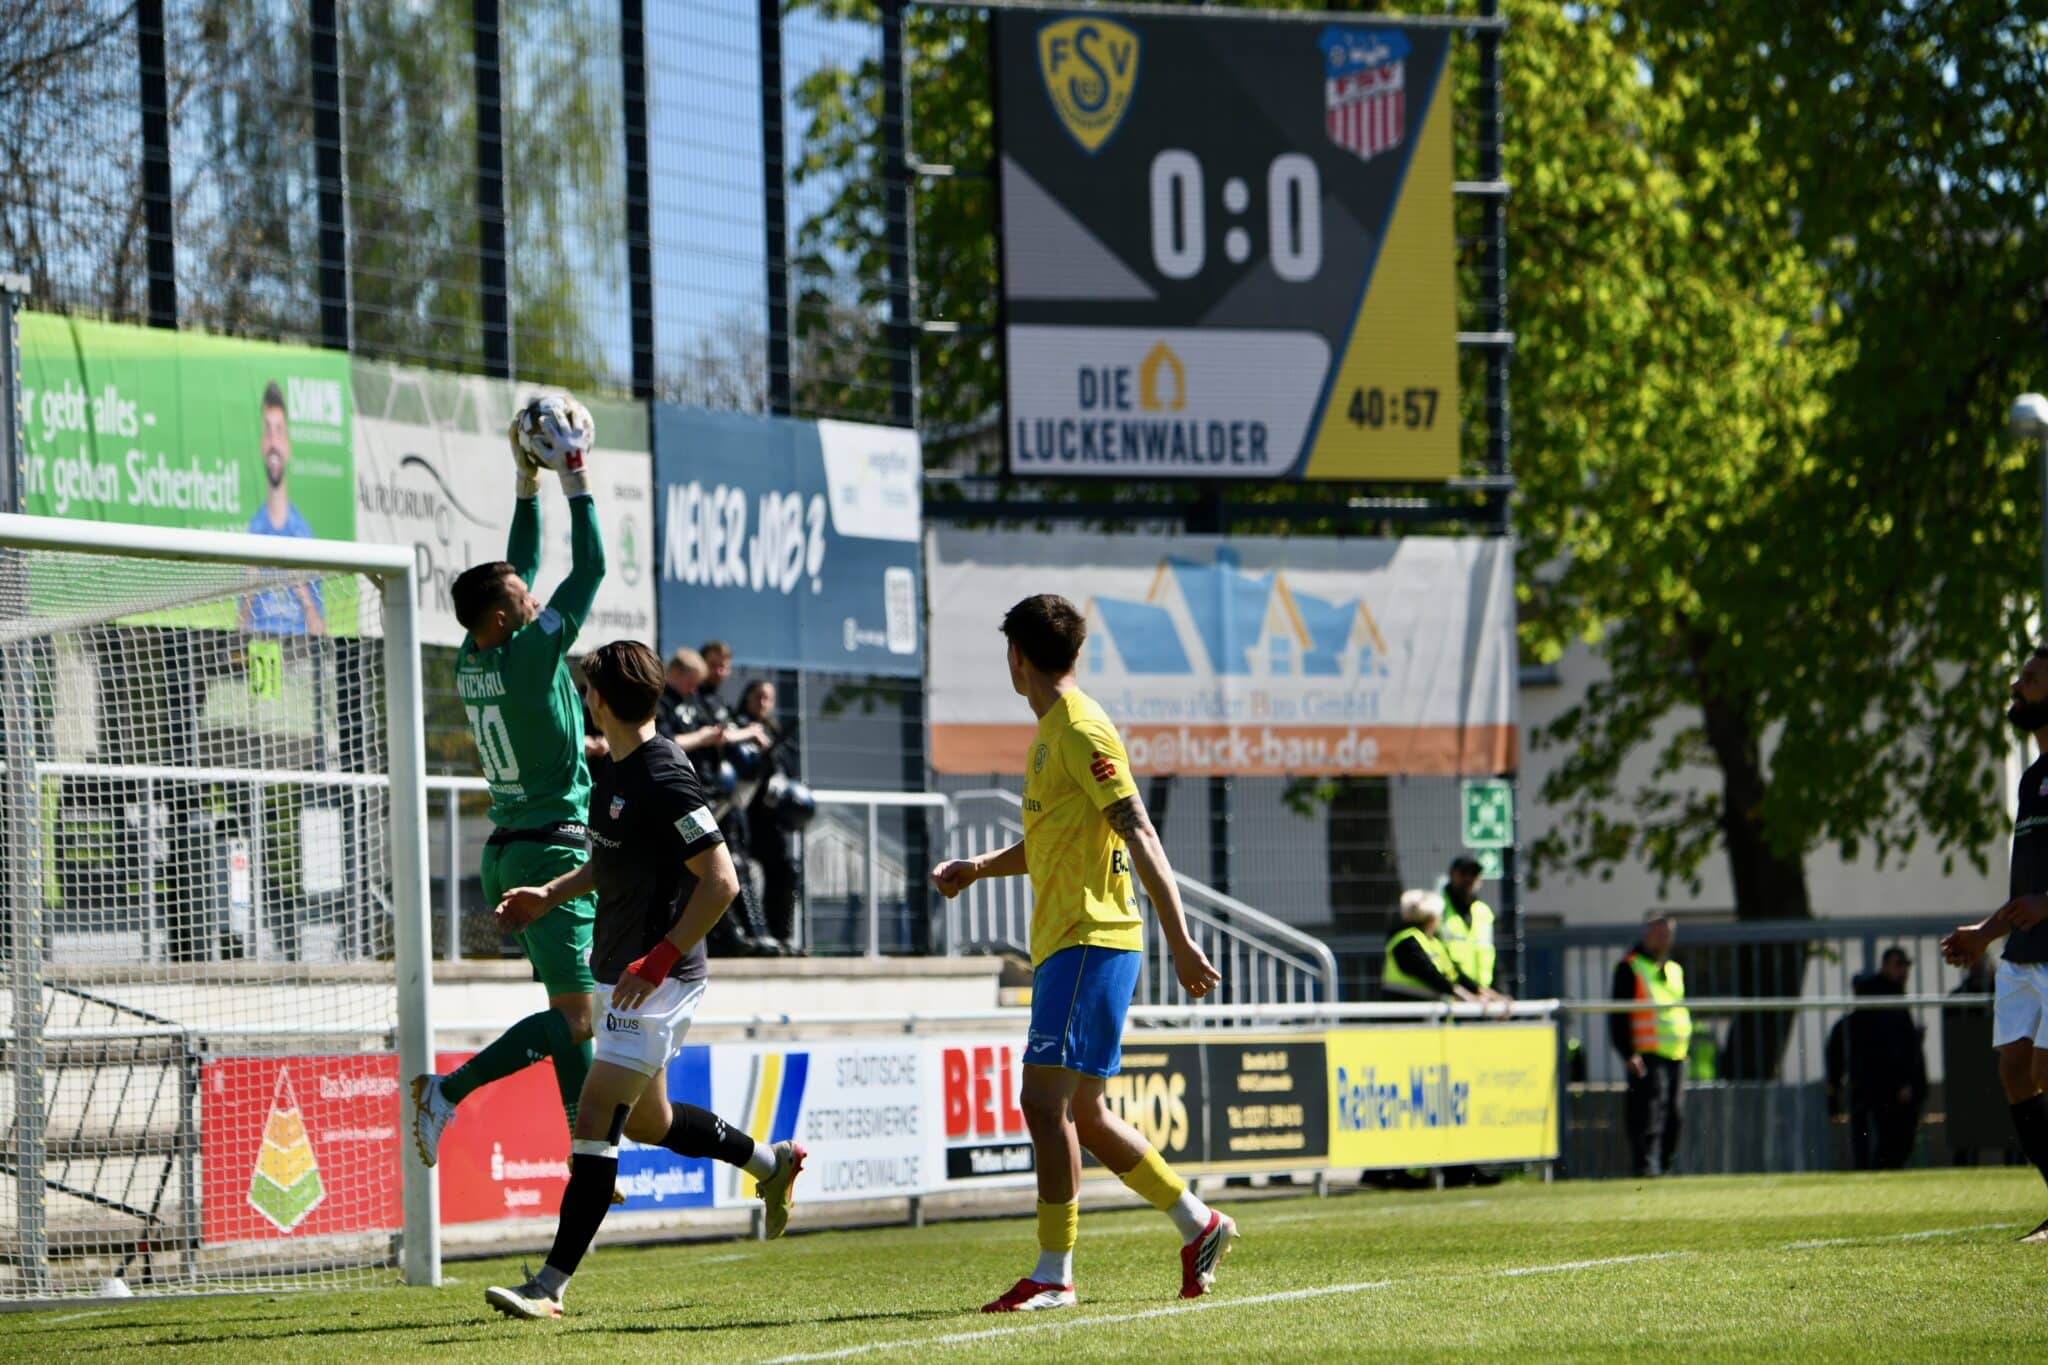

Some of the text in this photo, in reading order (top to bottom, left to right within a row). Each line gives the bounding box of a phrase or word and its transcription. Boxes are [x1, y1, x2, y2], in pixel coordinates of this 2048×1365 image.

[1150, 148, 1323, 283] 0:0
[41, 377, 88, 442] gebt
[95, 384, 138, 437] alles
[1079, 367, 1131, 409] DIE
[1348, 388, 1440, 429] 40:57
[1017, 419, 1268, 467] LUCKENWALDER
[53, 444, 120, 514] geben
[126, 449, 241, 514] Sicherheit!
[664, 480, 826, 595] NEUER JOB?
[943, 1046, 1028, 1137] BEL
[1105, 1071, 1189, 1152] THOS
[1337, 1064, 1469, 1131] Reifen-Müller
